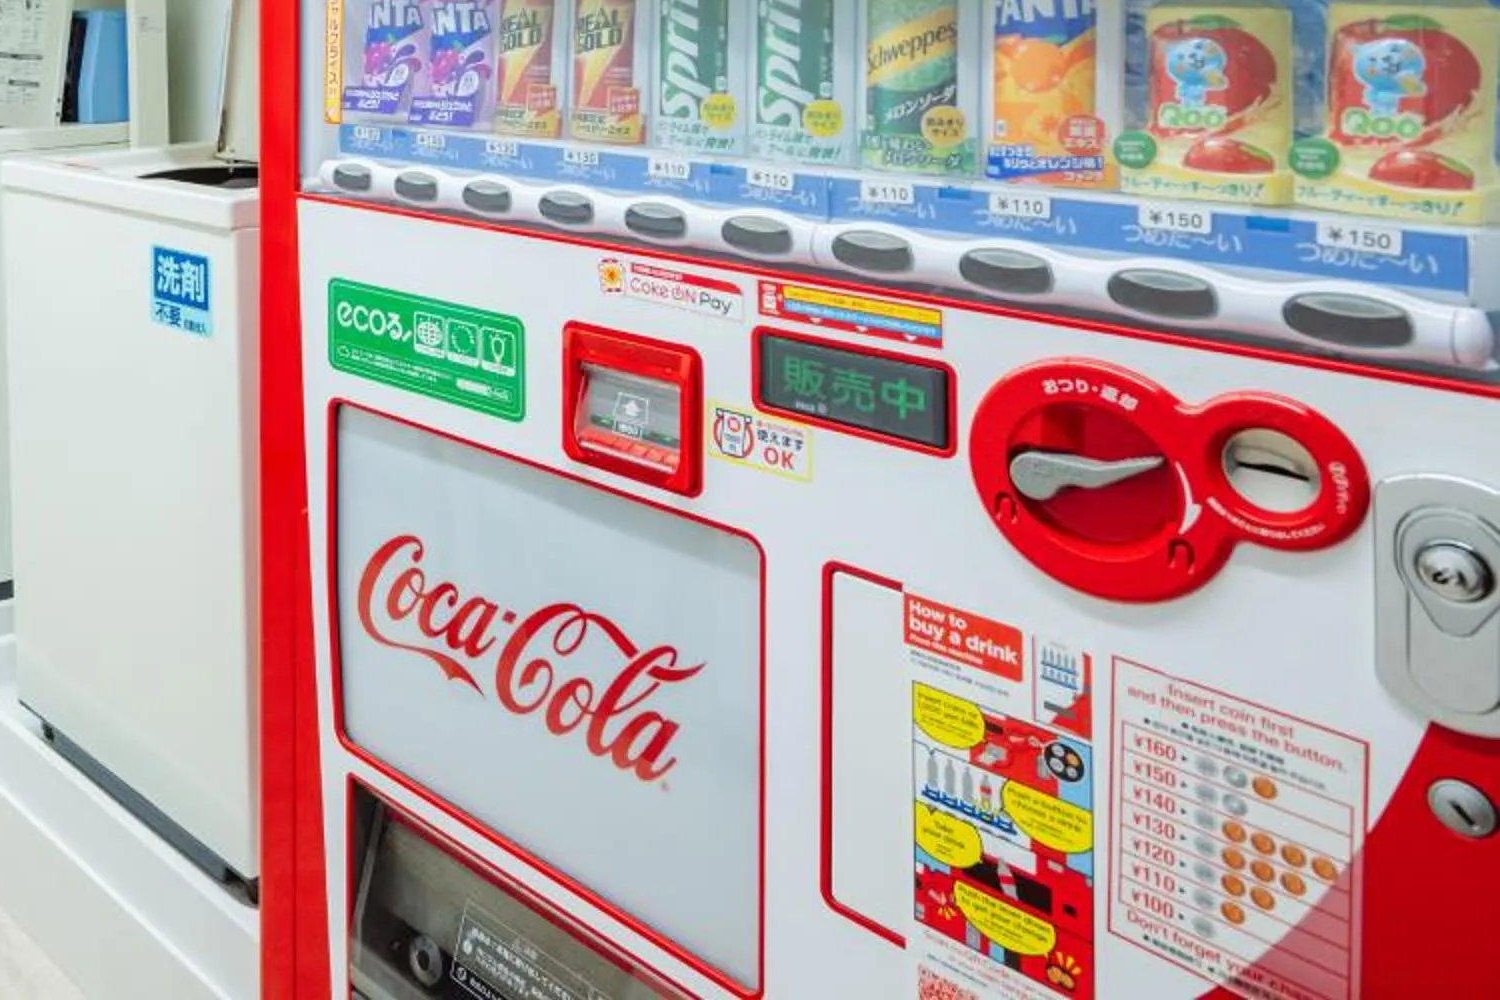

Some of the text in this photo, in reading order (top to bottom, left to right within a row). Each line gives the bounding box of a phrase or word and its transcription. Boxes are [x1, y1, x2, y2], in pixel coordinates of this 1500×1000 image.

[653, 161, 686, 176] ¥110
[751, 172, 789, 188] ¥110
[867, 186, 909, 201] ¥110
[997, 196, 1044, 215] ¥110
[1149, 208, 1203, 230] ¥150
[1327, 226, 1392, 250] ¥150
[156, 253, 206, 303] 洗剤
[629, 277, 669, 299] Coke
[699, 292, 733, 316] Pay
[784, 354, 927, 420] 販売中
[763, 446, 796, 471] OK
[909, 600, 968, 631] How to
[909, 613, 1020, 665] buy a drink
[1166, 682, 1295, 739] Insert coin first
[1127, 685, 1349, 774] and then press the button.
[1133, 731, 1177, 763] ¥160
[1133, 757, 1176, 789] ¥150
[1133, 784, 1176, 815] ¥140
[1132, 812, 1175, 841] ¥130
[1132, 837, 1175, 868] ¥120
[1131, 863, 1175, 894] ¥110
[1131, 888, 1175, 921] ¥100
[1171, 928, 1222, 964] forget
